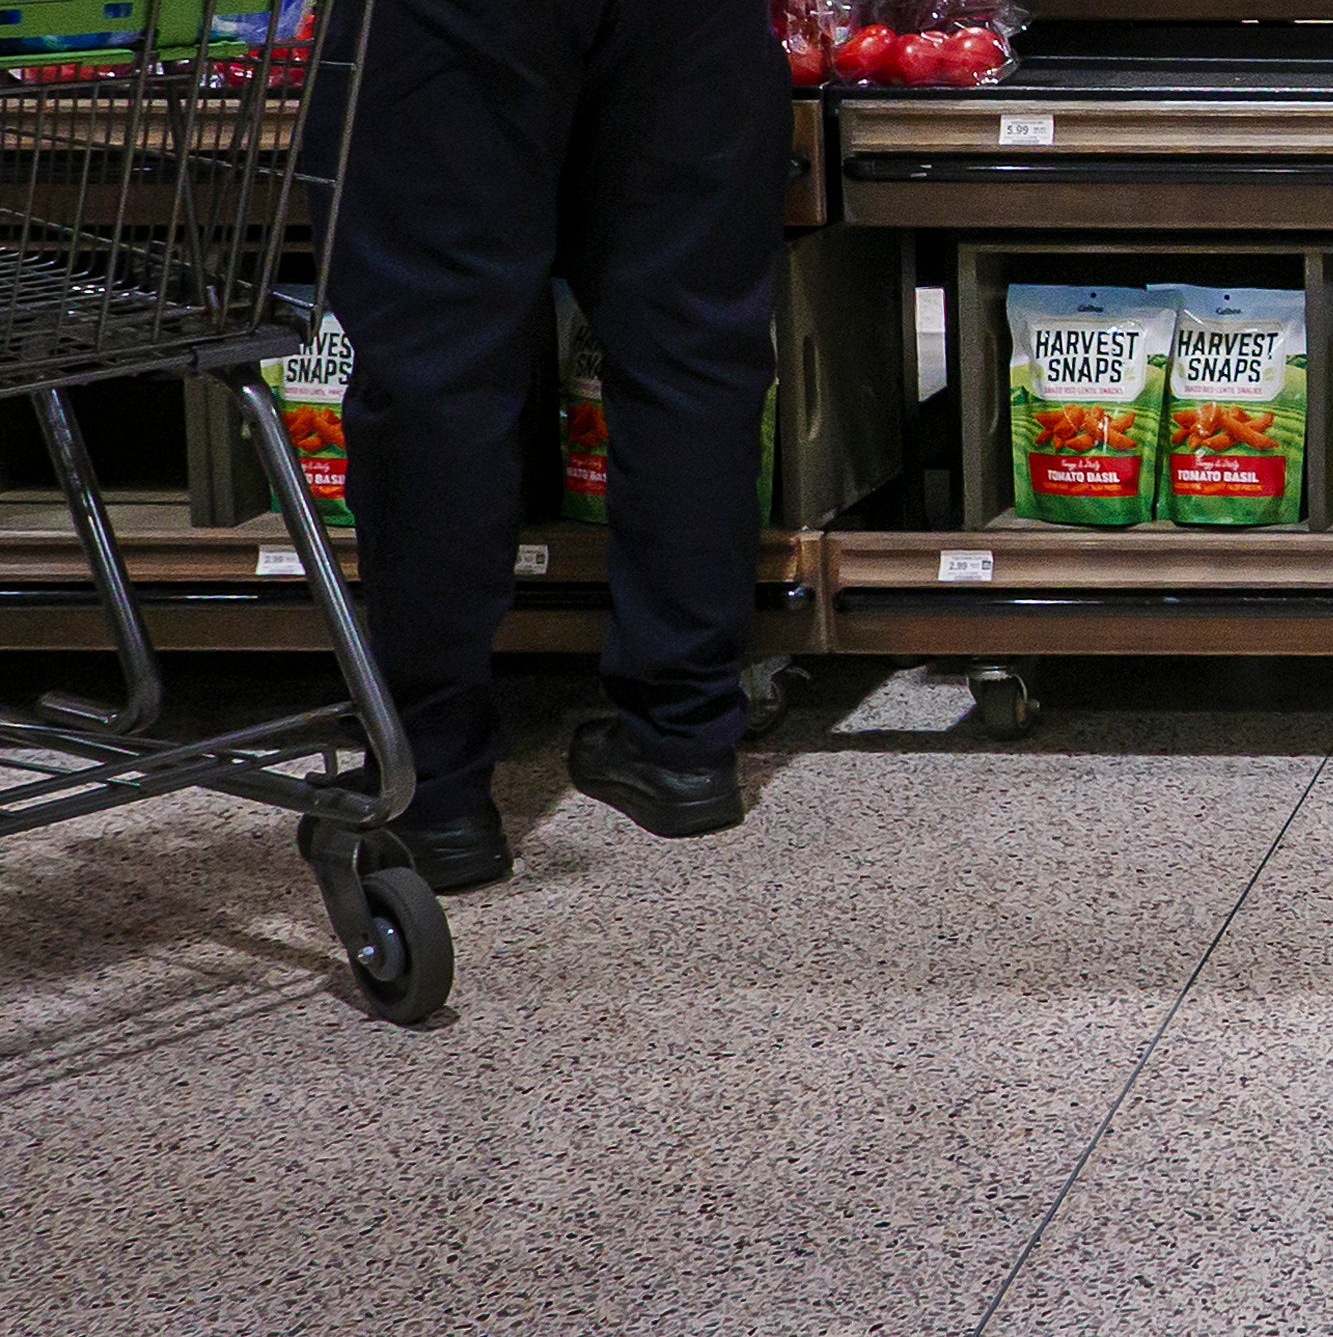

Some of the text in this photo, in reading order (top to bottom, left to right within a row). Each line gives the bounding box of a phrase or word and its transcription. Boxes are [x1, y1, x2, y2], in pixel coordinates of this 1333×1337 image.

[1036, 330, 1139, 360] HARVEST
[1178, 330, 1278, 359] HARVEST
[1048, 358, 1122, 383] SNAPS
[1188, 359, 1261, 383] SNAPS
[1048, 470, 1120, 483] TOMATO BASIL
[1178, 470, 1259, 483] TOMATO BASIL
